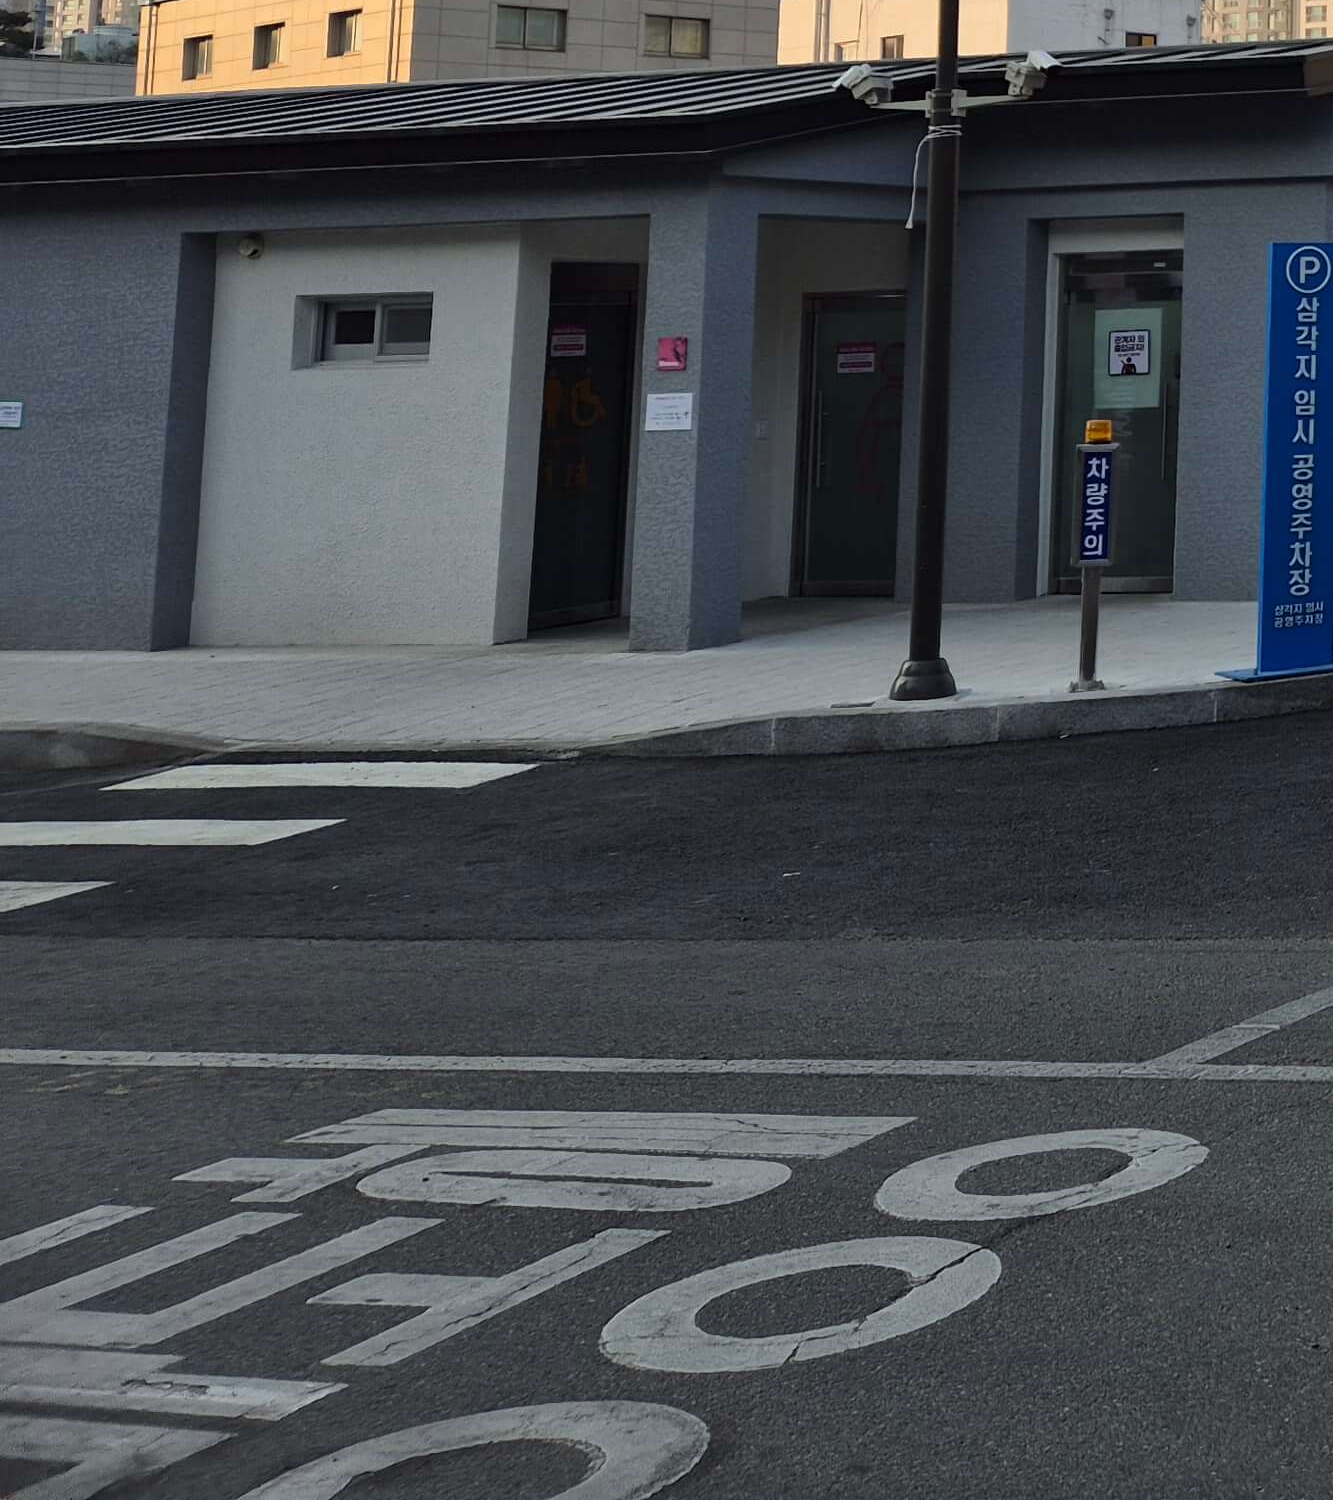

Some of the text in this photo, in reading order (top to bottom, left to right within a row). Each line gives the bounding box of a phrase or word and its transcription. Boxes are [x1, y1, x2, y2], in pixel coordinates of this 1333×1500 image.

[1299, 256, 1321, 284] P
[1288, 297, 1320, 596] 삼각지 임시 공영주차장
[1082, 457, 1109, 556] 차량주의
